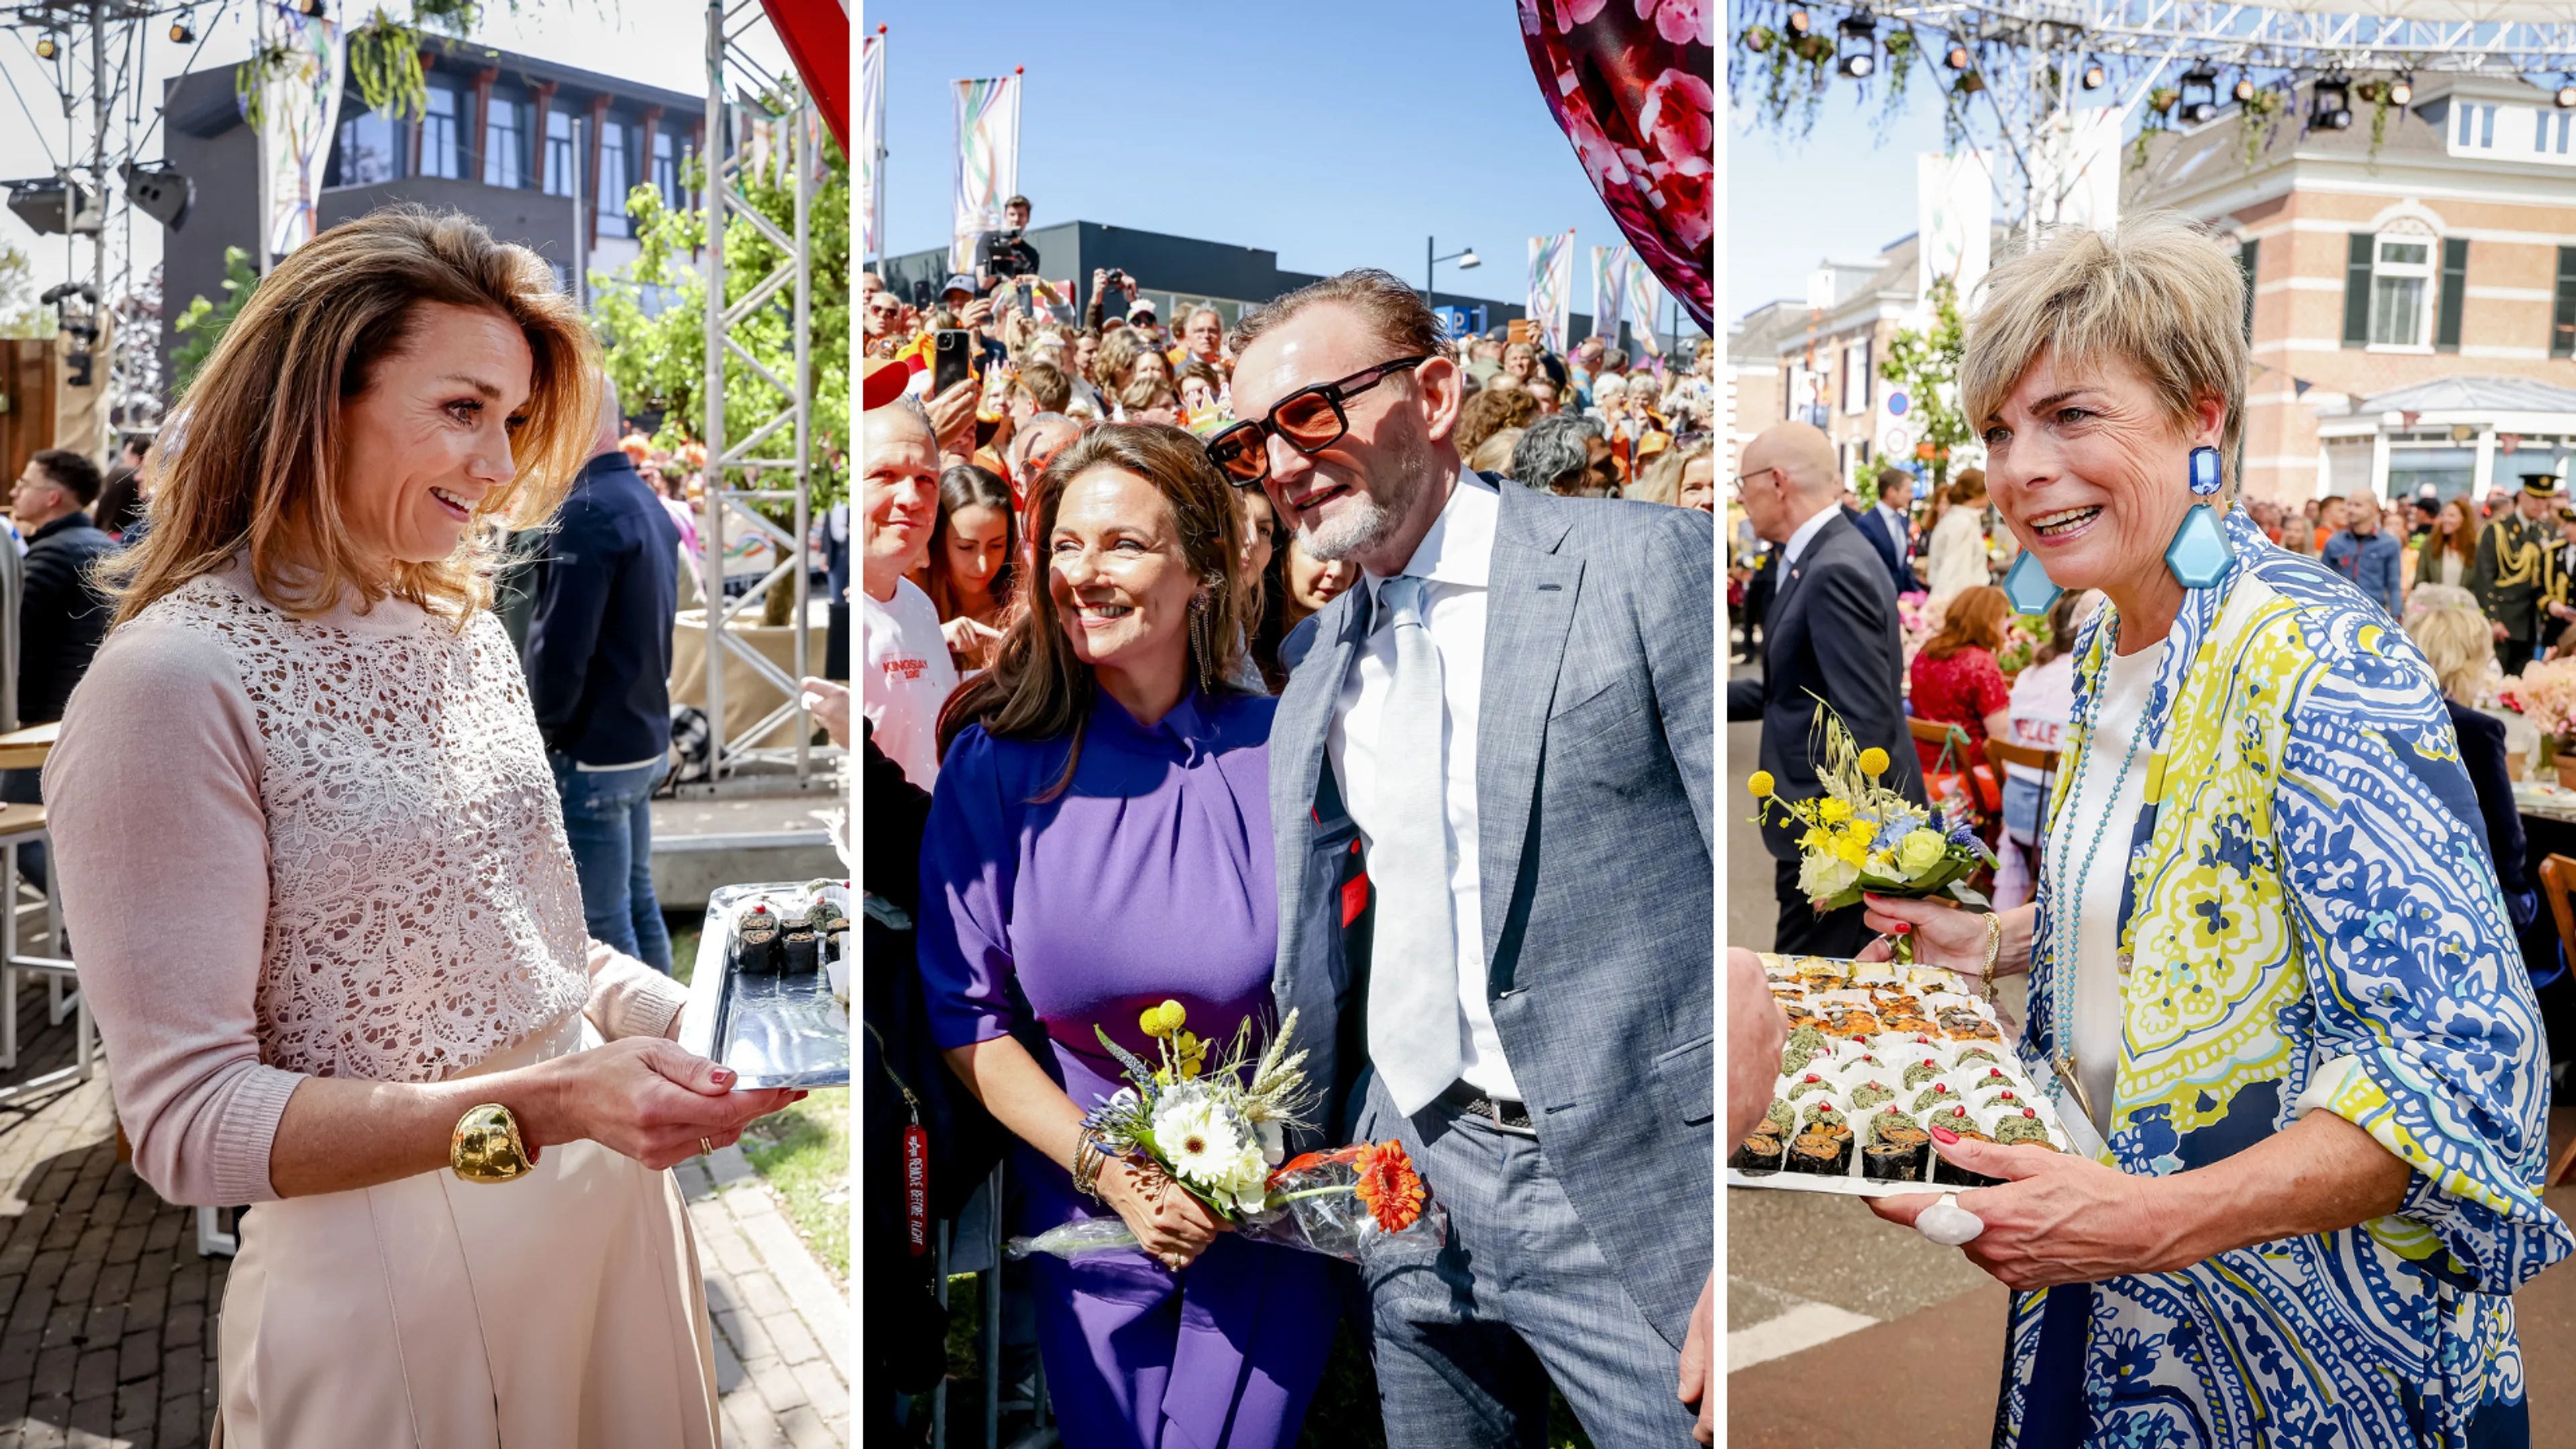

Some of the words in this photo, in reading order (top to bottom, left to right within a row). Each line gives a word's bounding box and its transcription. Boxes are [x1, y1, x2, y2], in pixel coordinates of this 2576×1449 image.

[909, 1157, 923, 1187] REMOVE
[910, 1189, 923, 1218] BEFORE
[911, 1220, 923, 1245] FLIGHT
